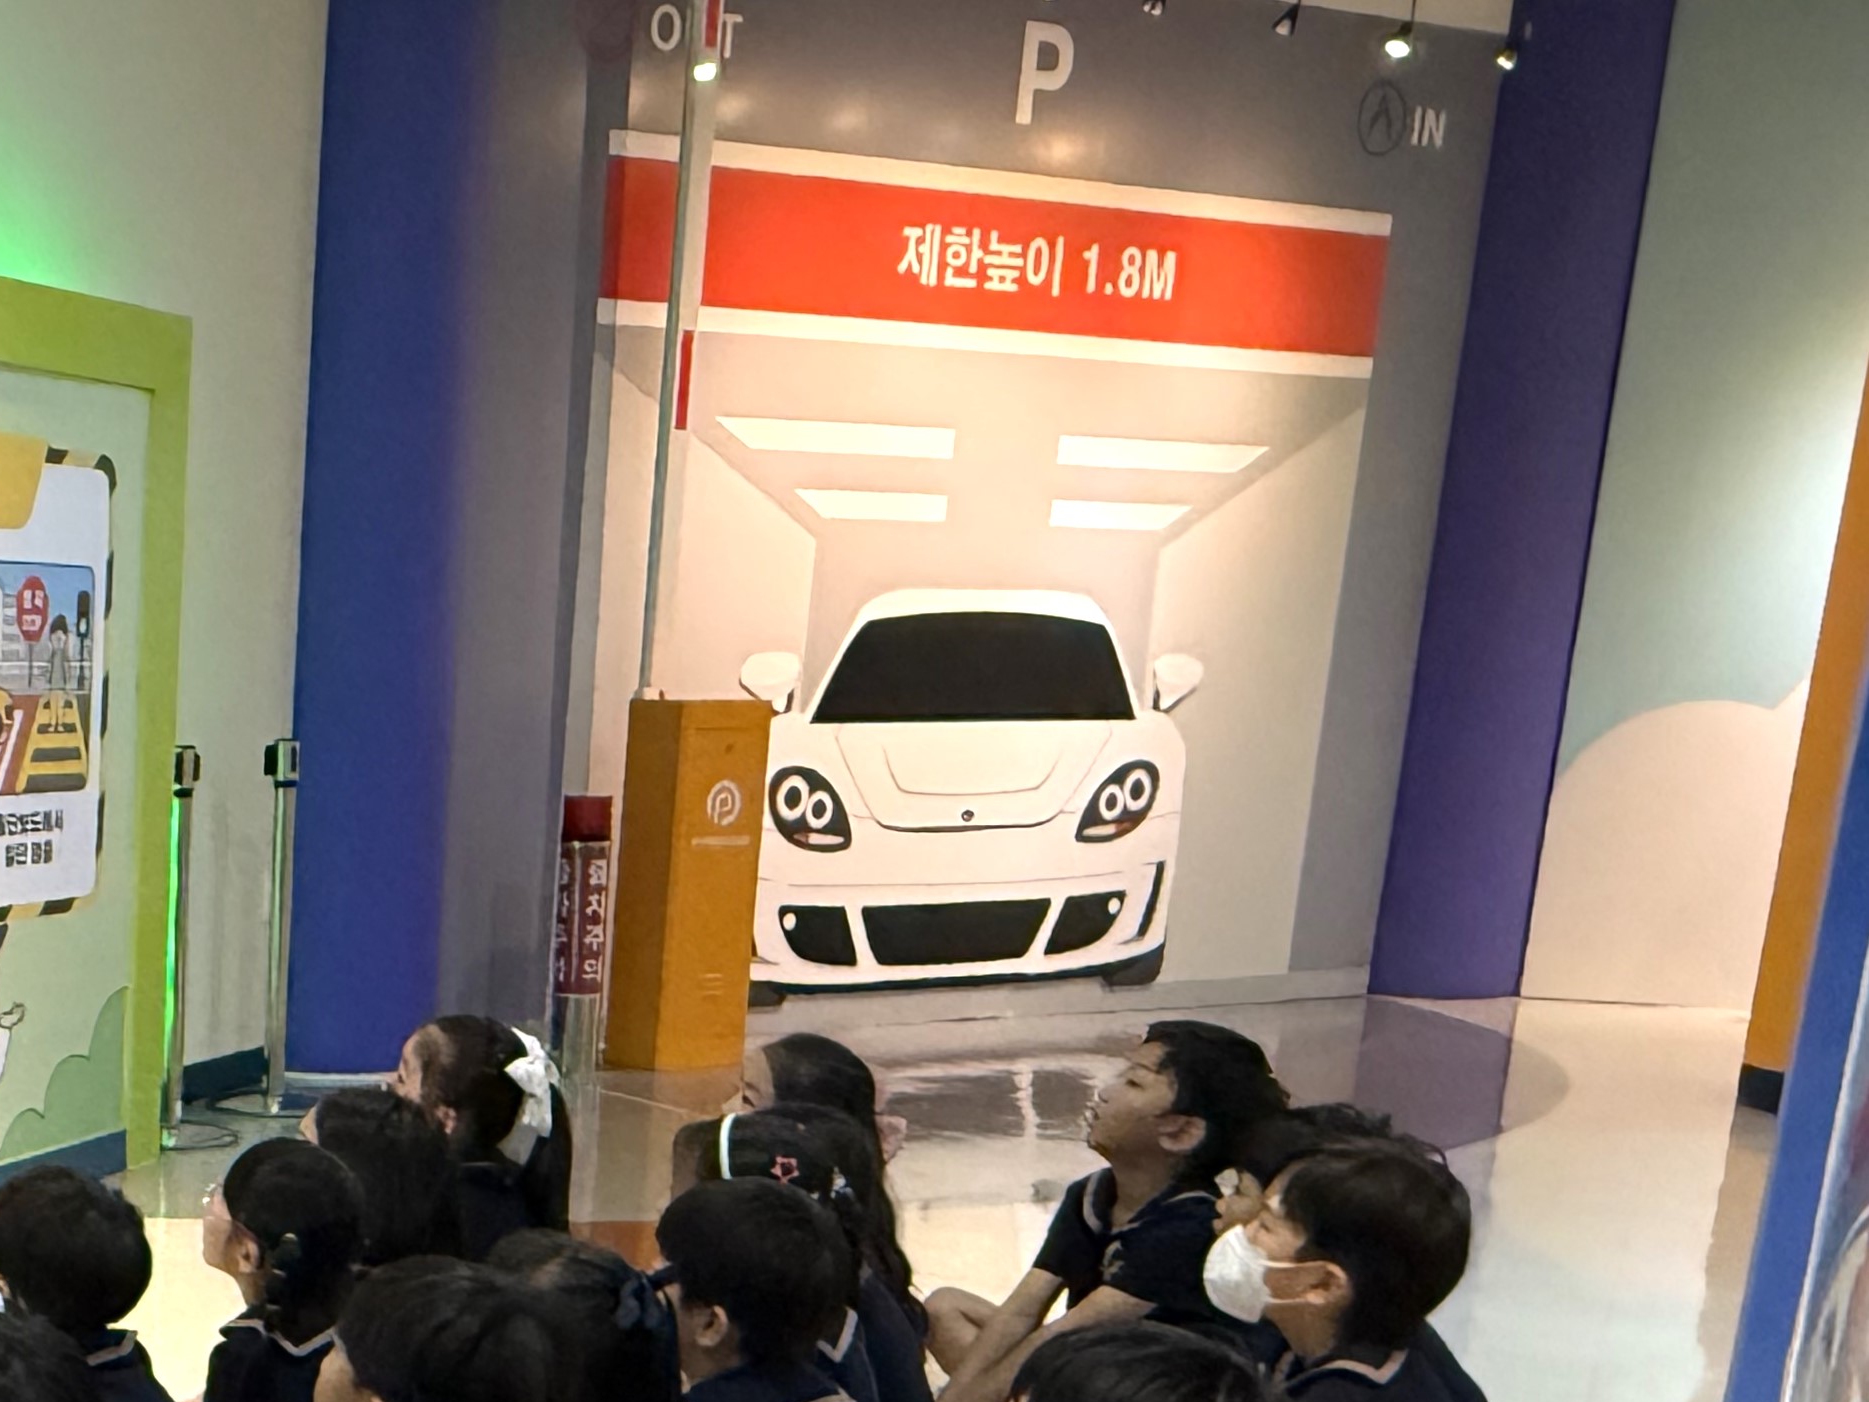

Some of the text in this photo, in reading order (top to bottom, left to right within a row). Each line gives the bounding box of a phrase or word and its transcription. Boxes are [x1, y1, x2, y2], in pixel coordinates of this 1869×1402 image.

[651, 4, 744, 58] OT
[1016, 20, 1075, 126] P
[1411, 105, 1446, 150] IN
[897, 223, 1177, 301] 제한높이 1.8M
